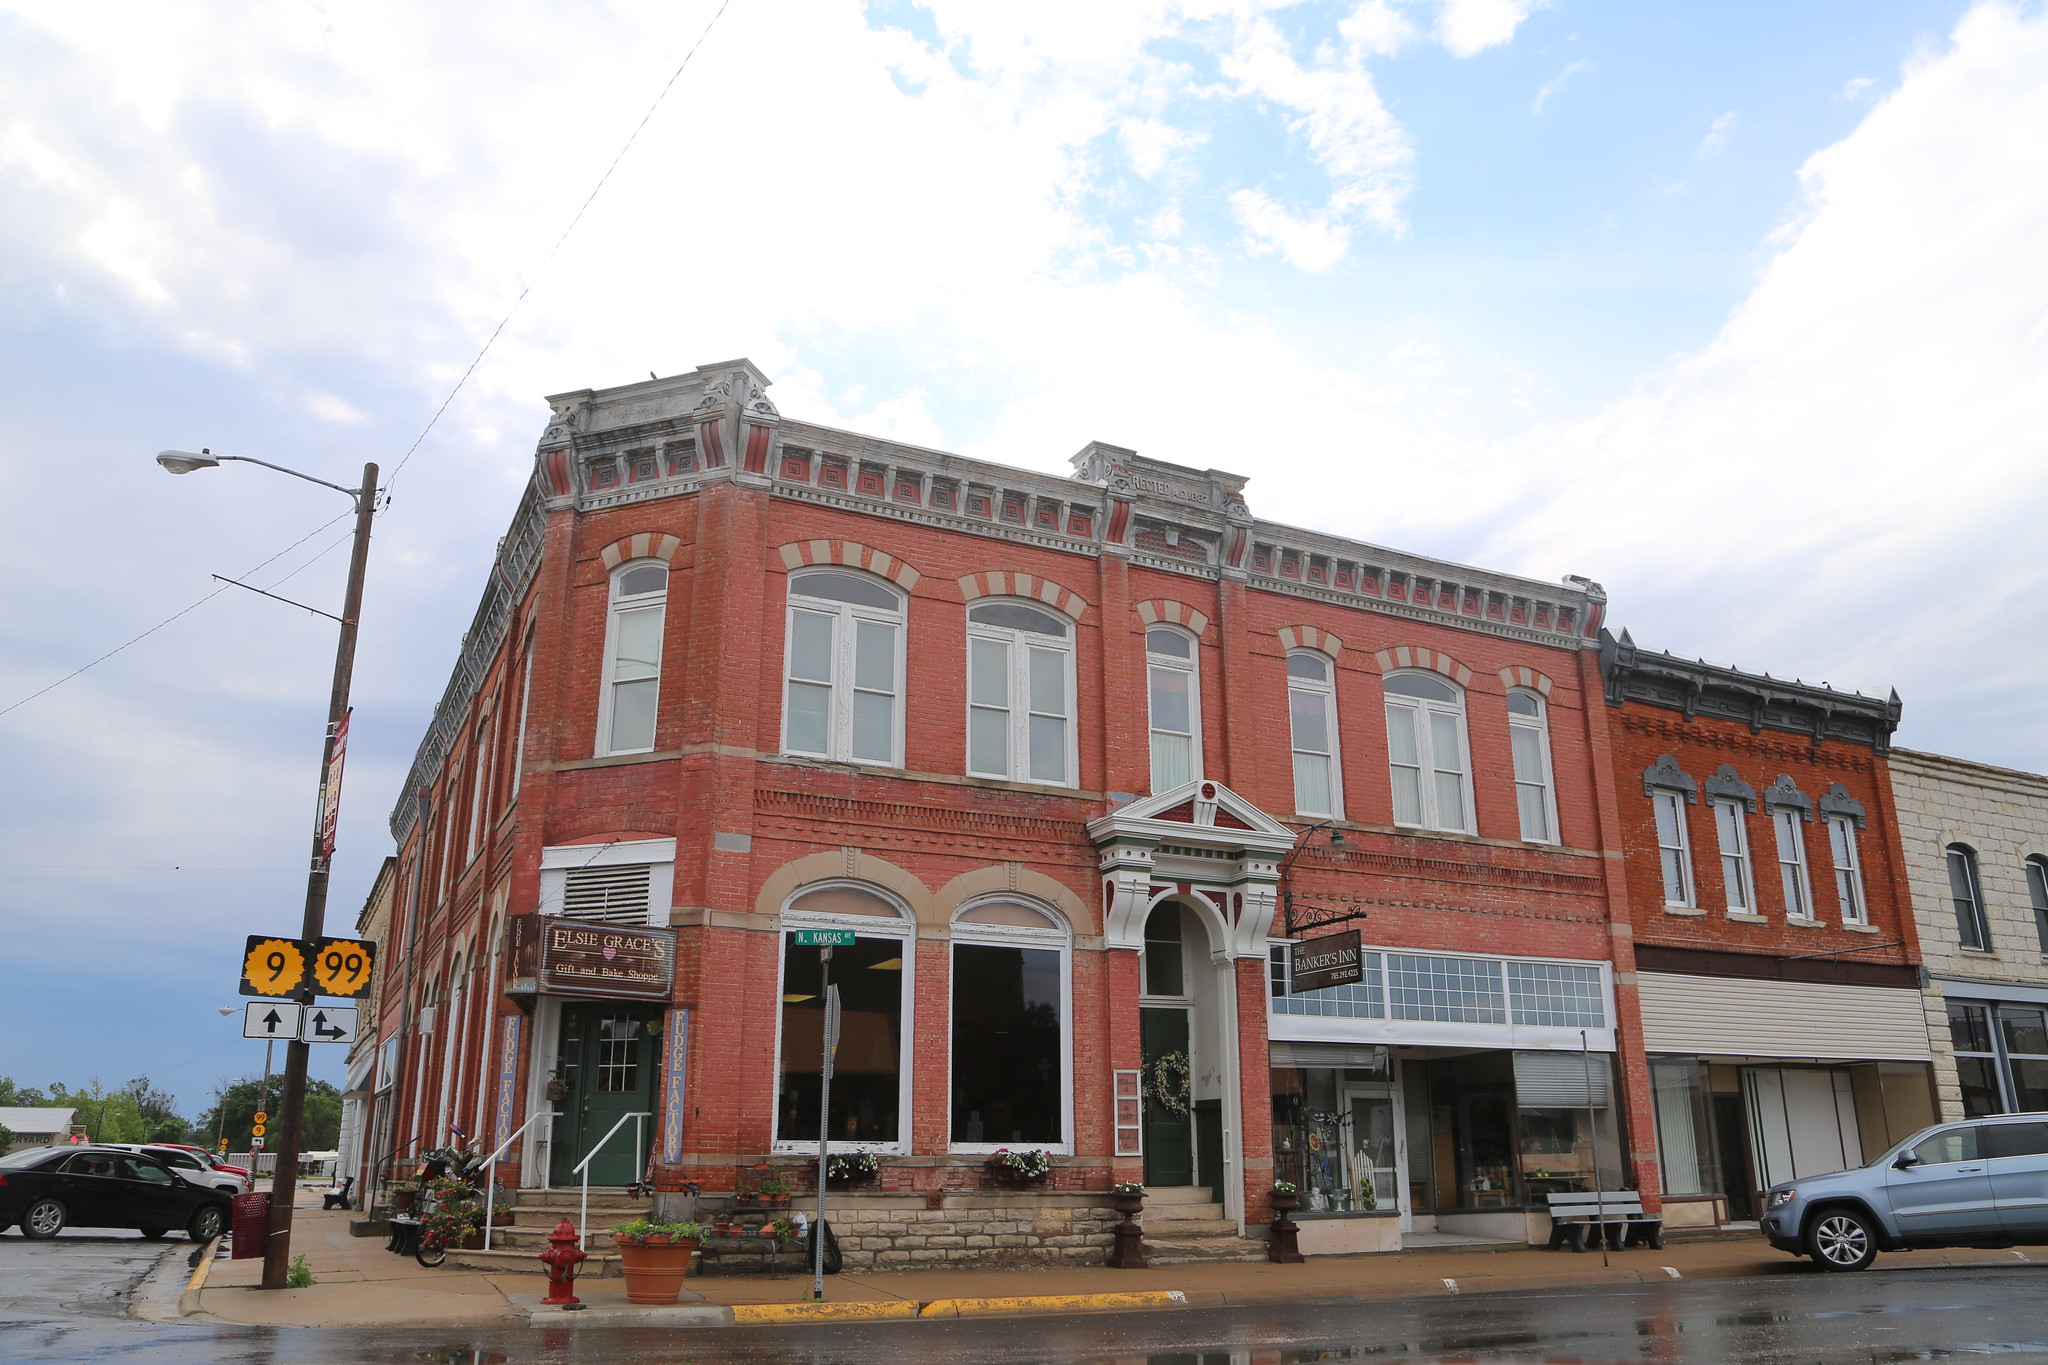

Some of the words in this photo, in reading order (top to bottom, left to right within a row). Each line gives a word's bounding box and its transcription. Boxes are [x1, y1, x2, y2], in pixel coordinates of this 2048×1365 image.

[1132, 475, 1170, 495] RECTED
[553, 929, 599, 949] ELSIE
[603, 934, 666, 959] GRACE'S
[798, 932, 807, 943] N.
[813, 932, 842, 944] KANSAS
[1294, 946, 1306, 956] THE
[266, 951, 286, 983] 9
[325, 951, 363, 984] 99
[556, 963, 575, 974] Gift
[580, 966, 597, 976] and
[602, 968, 624, 978] Bake
[628, 969, 658, 983] Shoppe
[1295, 952, 1337, 971] BANKER'S
[1339, 949, 1356, 963] INN
[504, 1017, 517, 1074] FUDGE
[673, 1011, 686, 1072] FUDGE
[498, 1080, 512, 1161] FACTORY
[667, 1076, 683, 1162] FACTORY
[11, 1136, 50, 1144] RYARD
